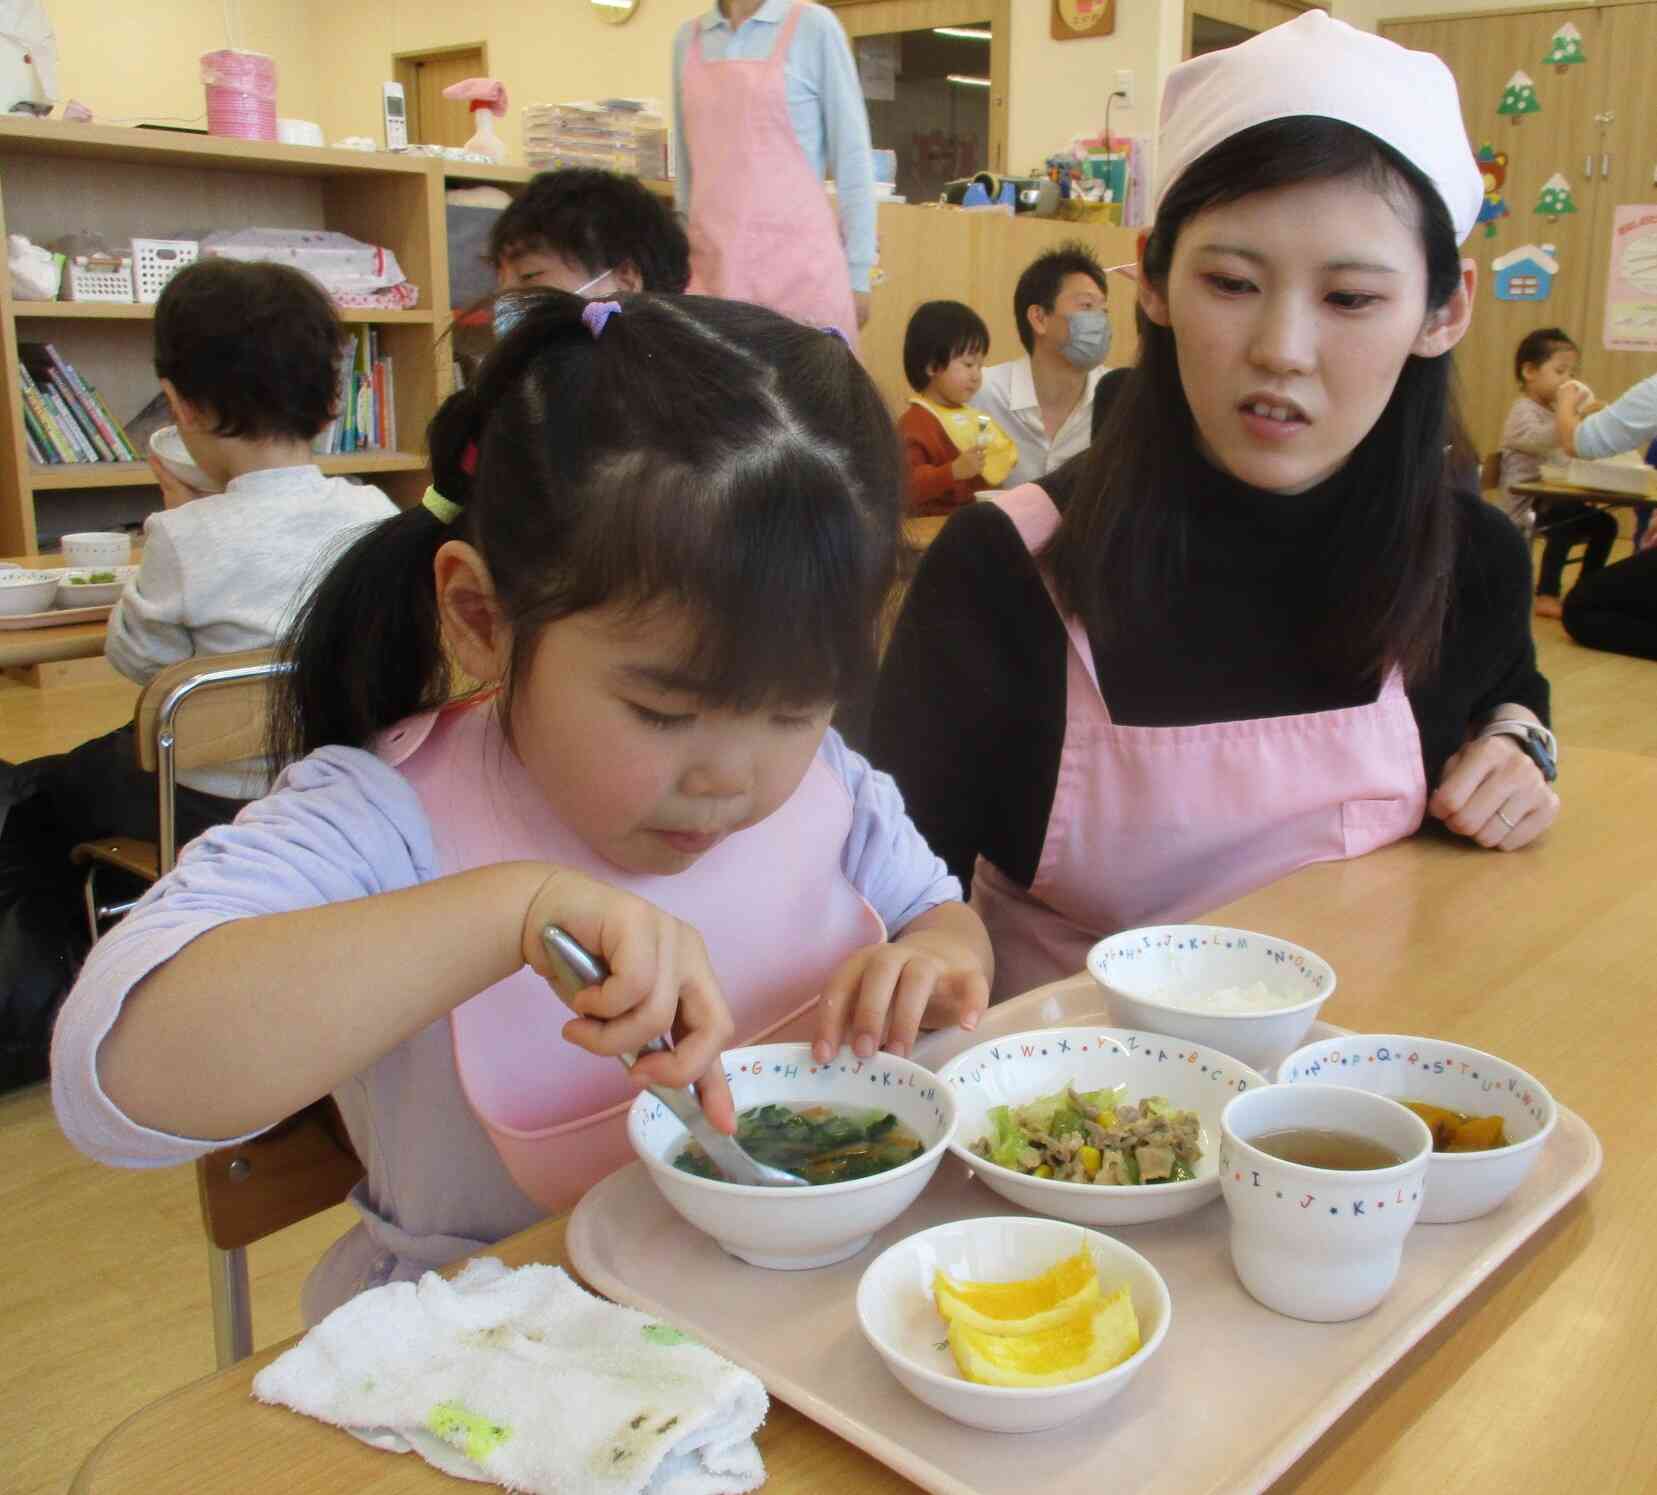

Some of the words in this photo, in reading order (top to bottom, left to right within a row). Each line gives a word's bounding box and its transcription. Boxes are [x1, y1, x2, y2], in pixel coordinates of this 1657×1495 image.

[1189, 938, 1199, 950] K
[751, 1060, 763, 1076] G
[784, 1065, 798, 1079] H
[1021, 1044, 1034, 1057] W
[1058, 1039, 1071, 1053] X
[1158, 1049, 1168, 1062] A
[1211, 1070, 1223, 1081] C
[1237, 1079, 1247, 1092] D
[1376, 1047, 1392, 1061] Q
[1432, 1060, 1445, 1074] S
[882, 1072, 892, 1087] K
[1251, 1170, 1261, 1187] I
[1299, 1193, 1316, 1209] J
[1352, 1199, 1366, 1217] K
